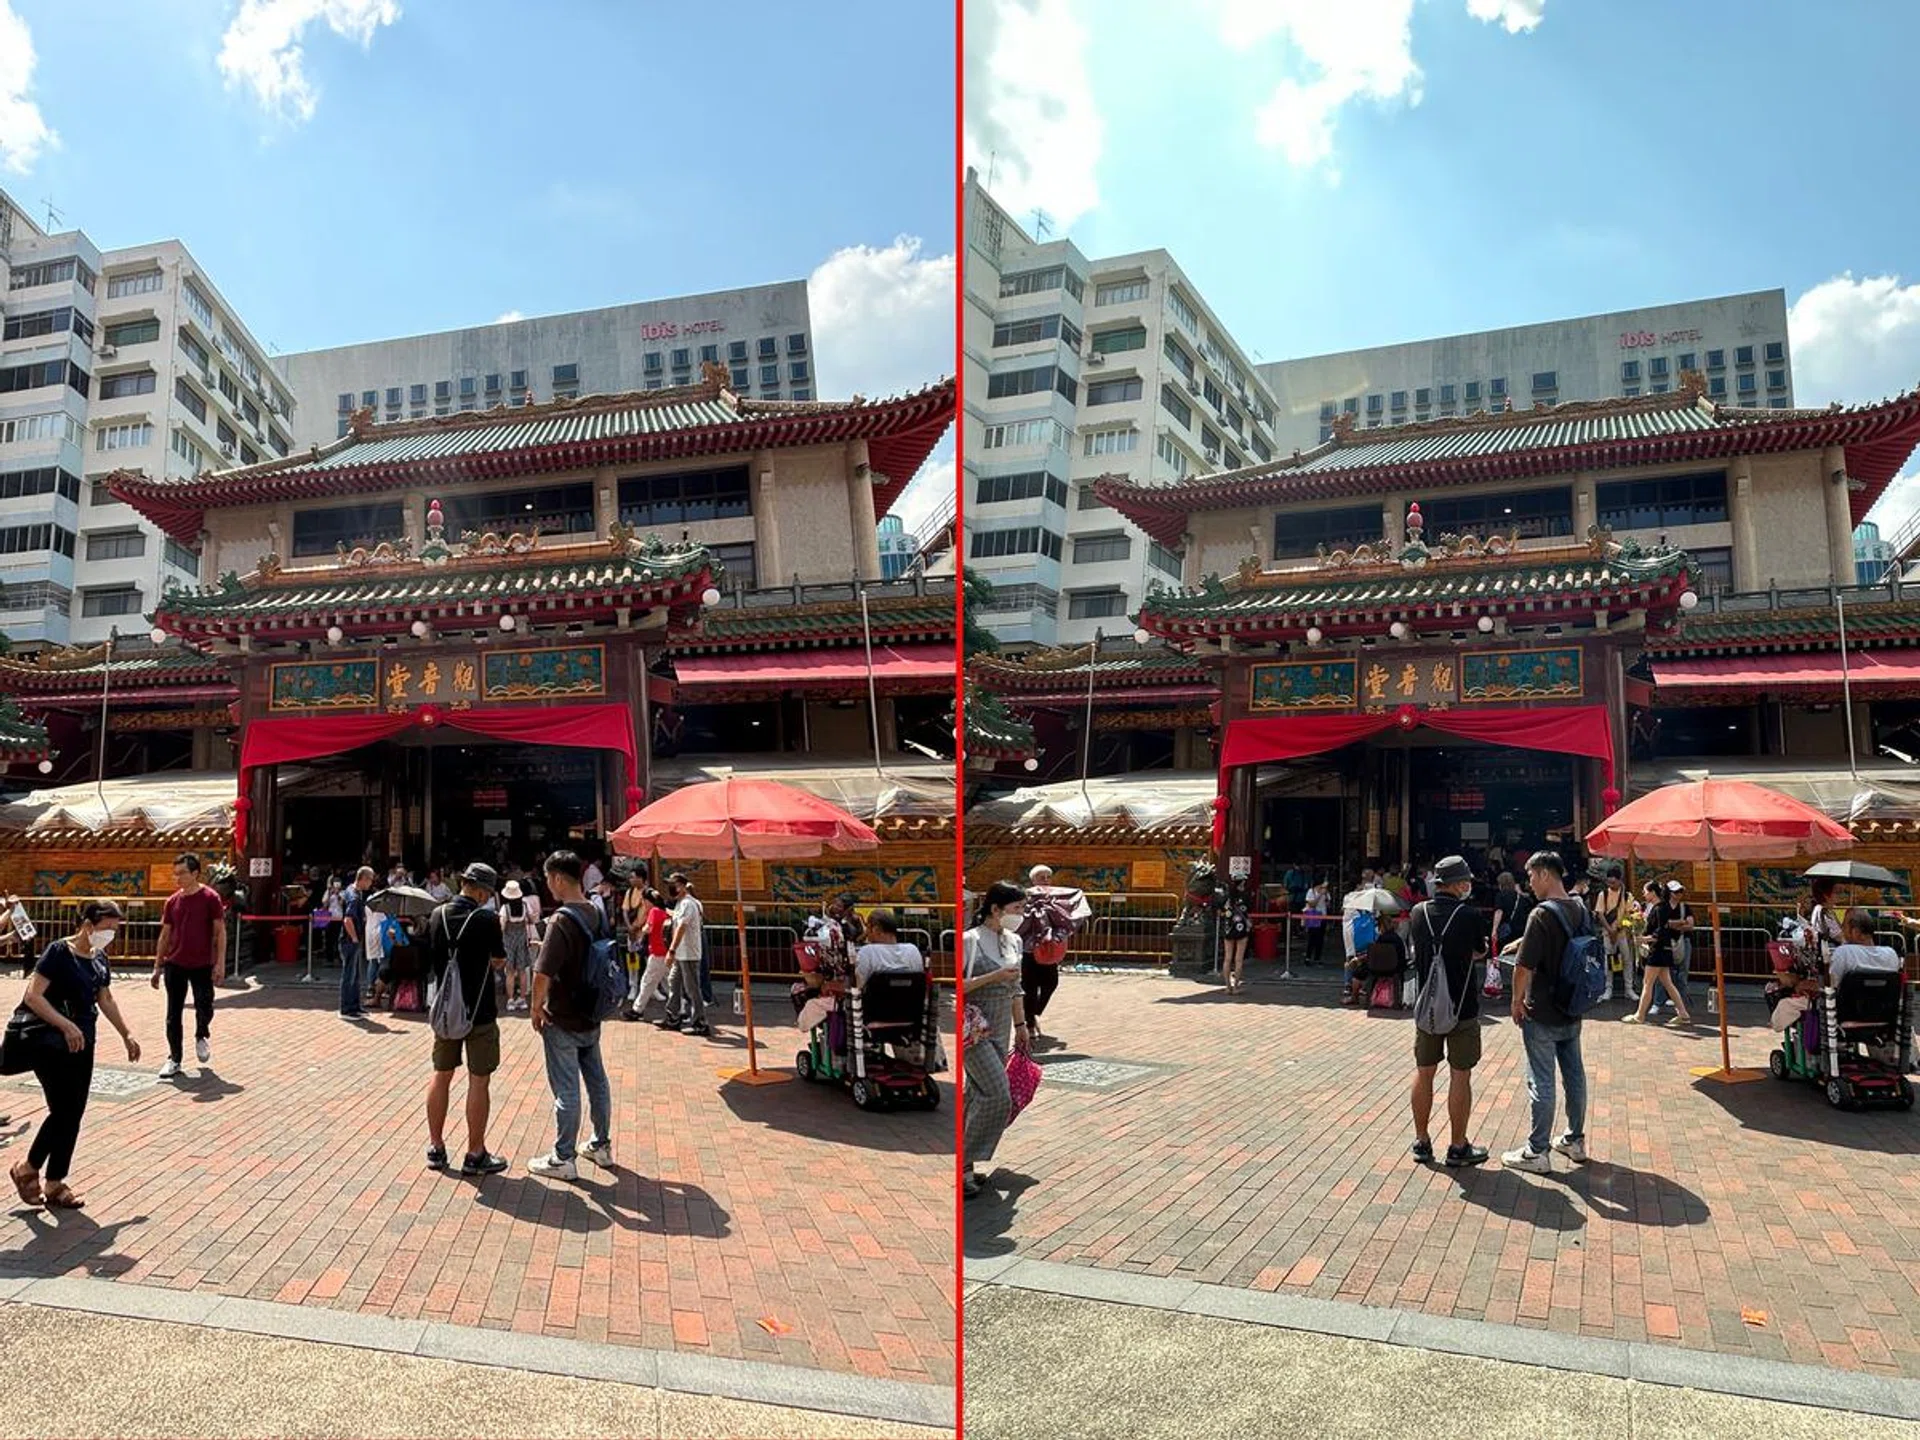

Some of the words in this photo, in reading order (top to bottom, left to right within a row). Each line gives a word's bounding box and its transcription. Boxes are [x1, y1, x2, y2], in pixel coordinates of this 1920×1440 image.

[641, 321, 678, 340] ibis
[682, 320, 727, 336] HOTEL
[1619, 330, 1656, 349] ibis
[1659, 328, 1703, 345] HOTEL
